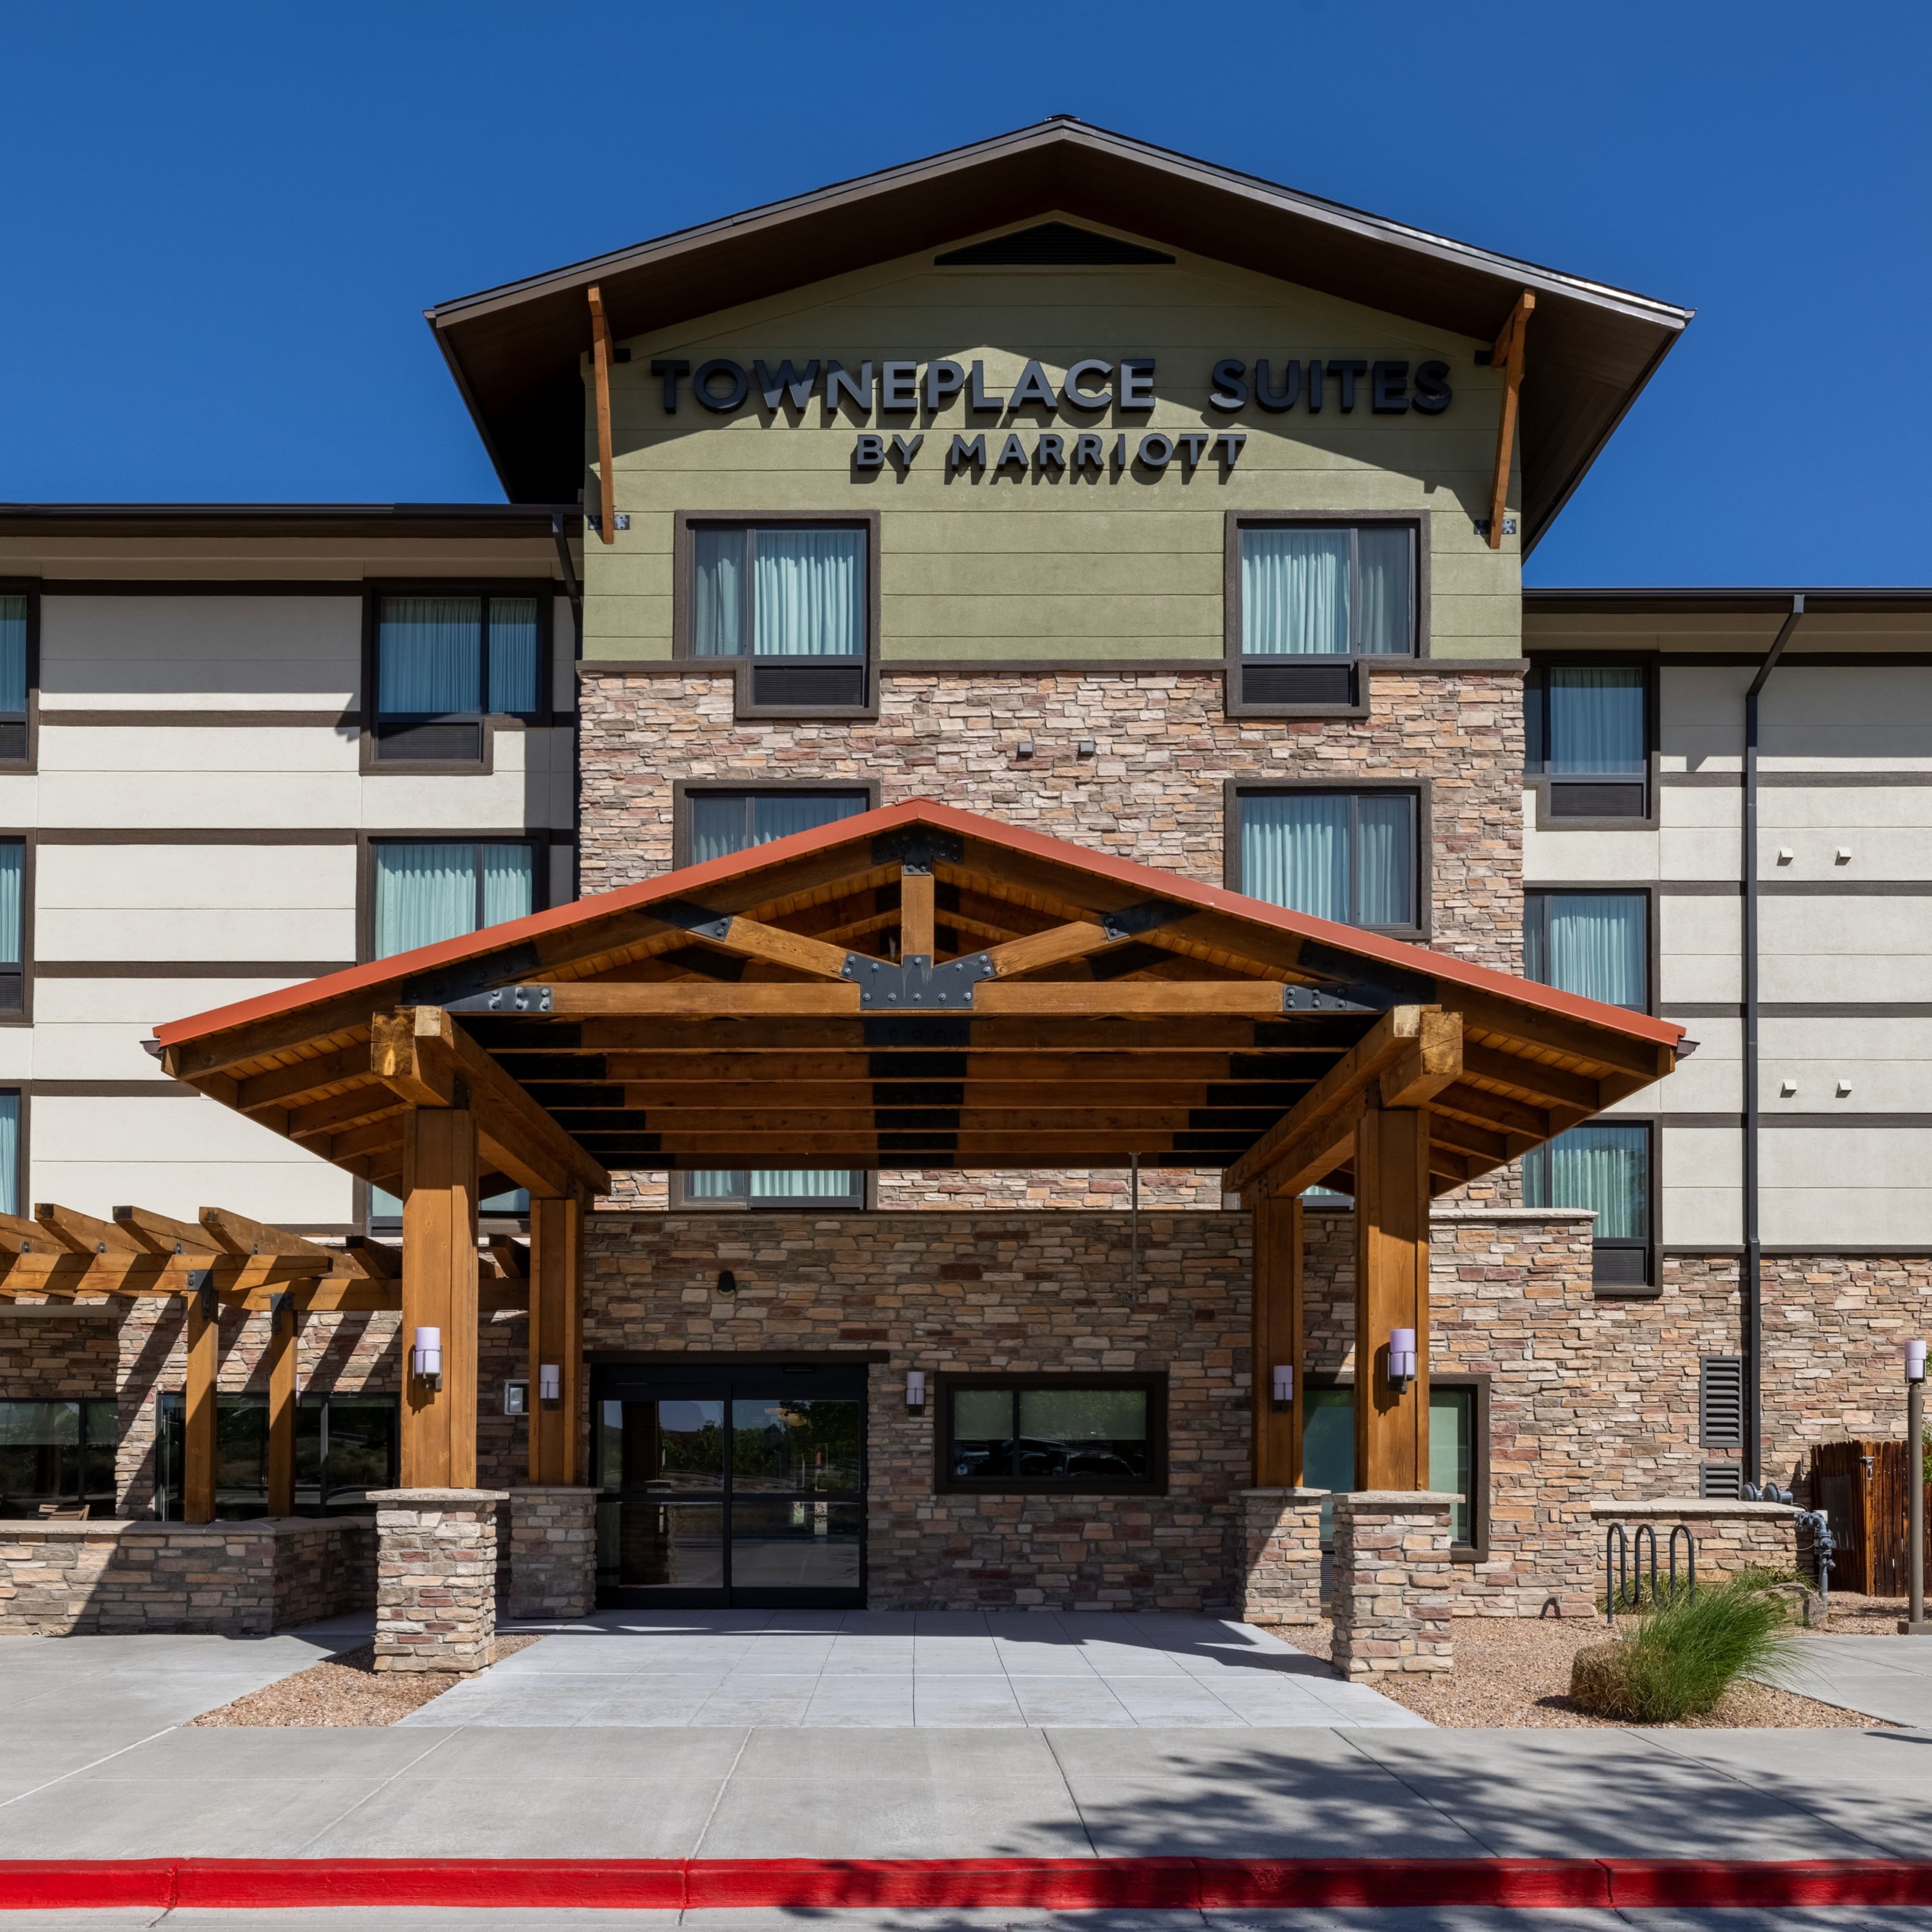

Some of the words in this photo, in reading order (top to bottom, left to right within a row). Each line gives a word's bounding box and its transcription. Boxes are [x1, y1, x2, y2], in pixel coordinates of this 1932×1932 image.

[651, 359, 1156, 415] TOWNEPLACE
[1209, 359, 1453, 415] SUITES
[856, 434, 924, 471] BY
[951, 433, 1247, 471] MARRIOTT
